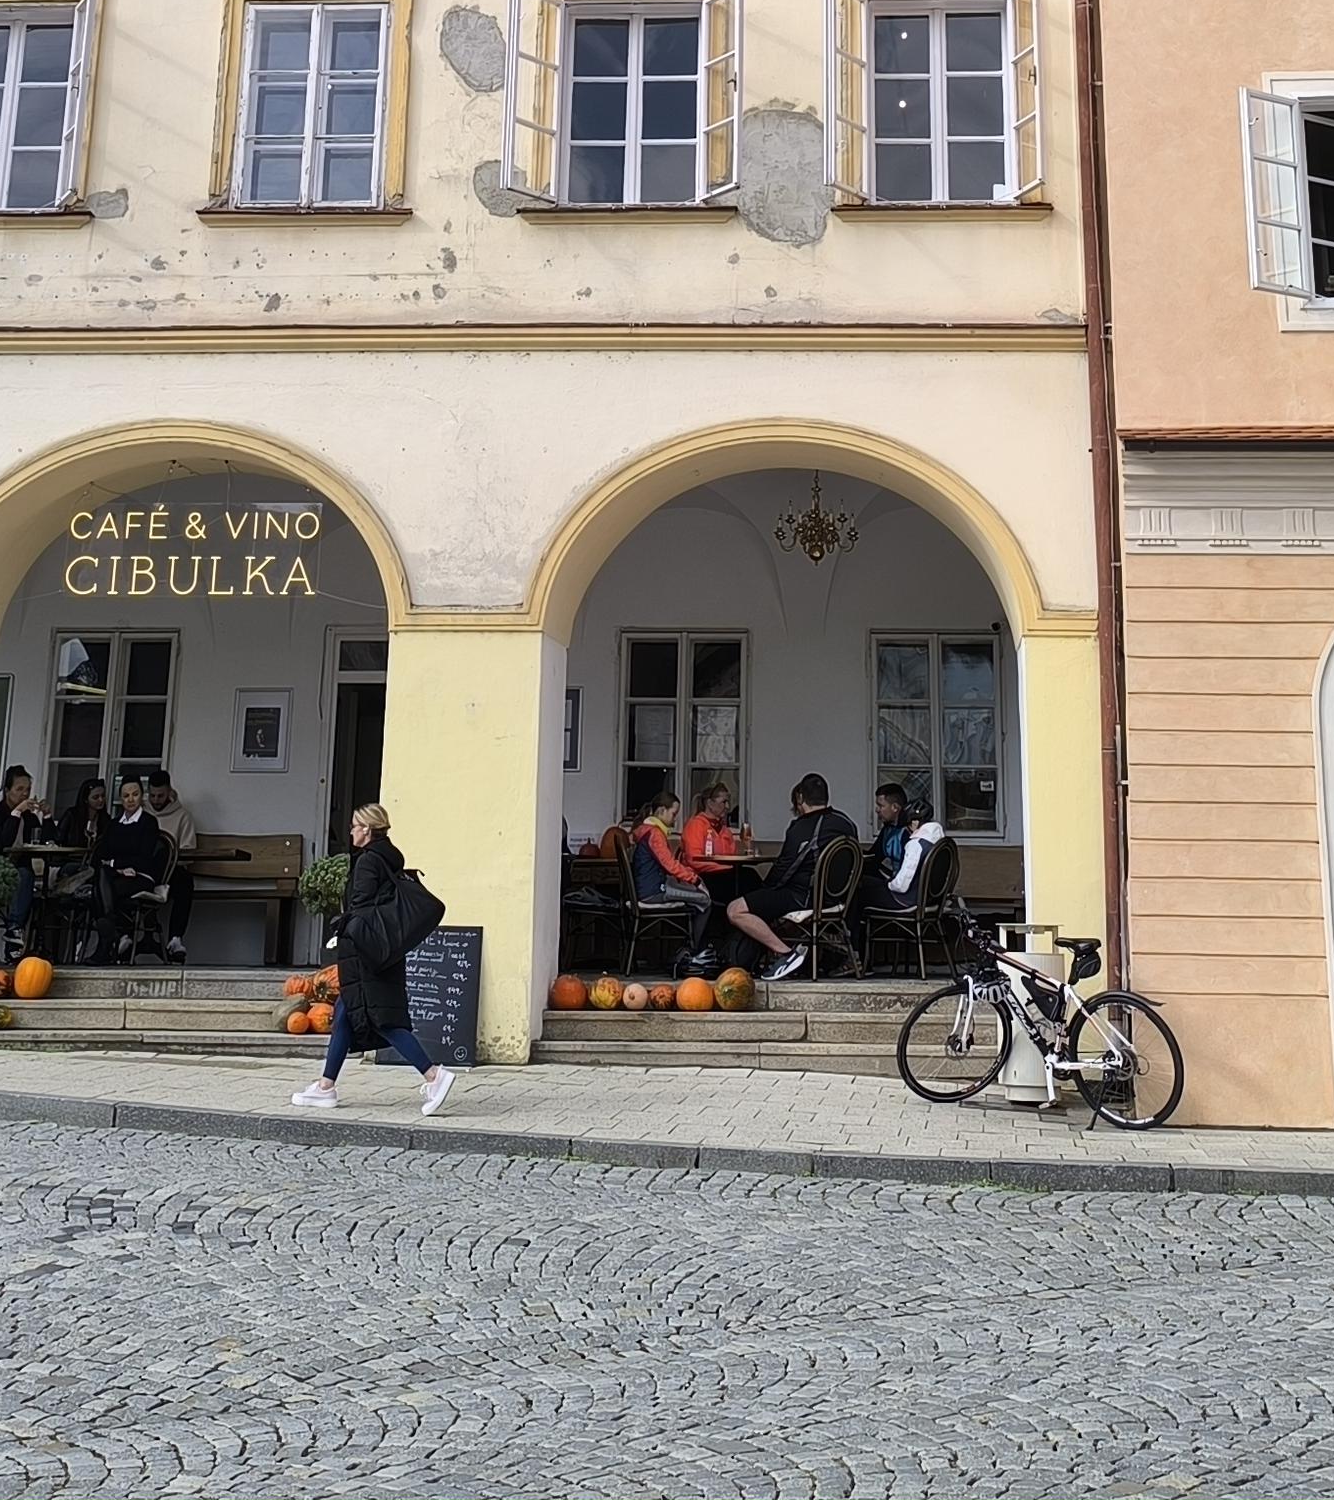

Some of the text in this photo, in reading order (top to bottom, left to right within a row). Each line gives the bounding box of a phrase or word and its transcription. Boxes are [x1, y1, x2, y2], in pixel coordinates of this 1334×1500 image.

[70, 504, 320, 540] CAFÉ & VINO
[65, 555, 317, 596] CIBULKA
